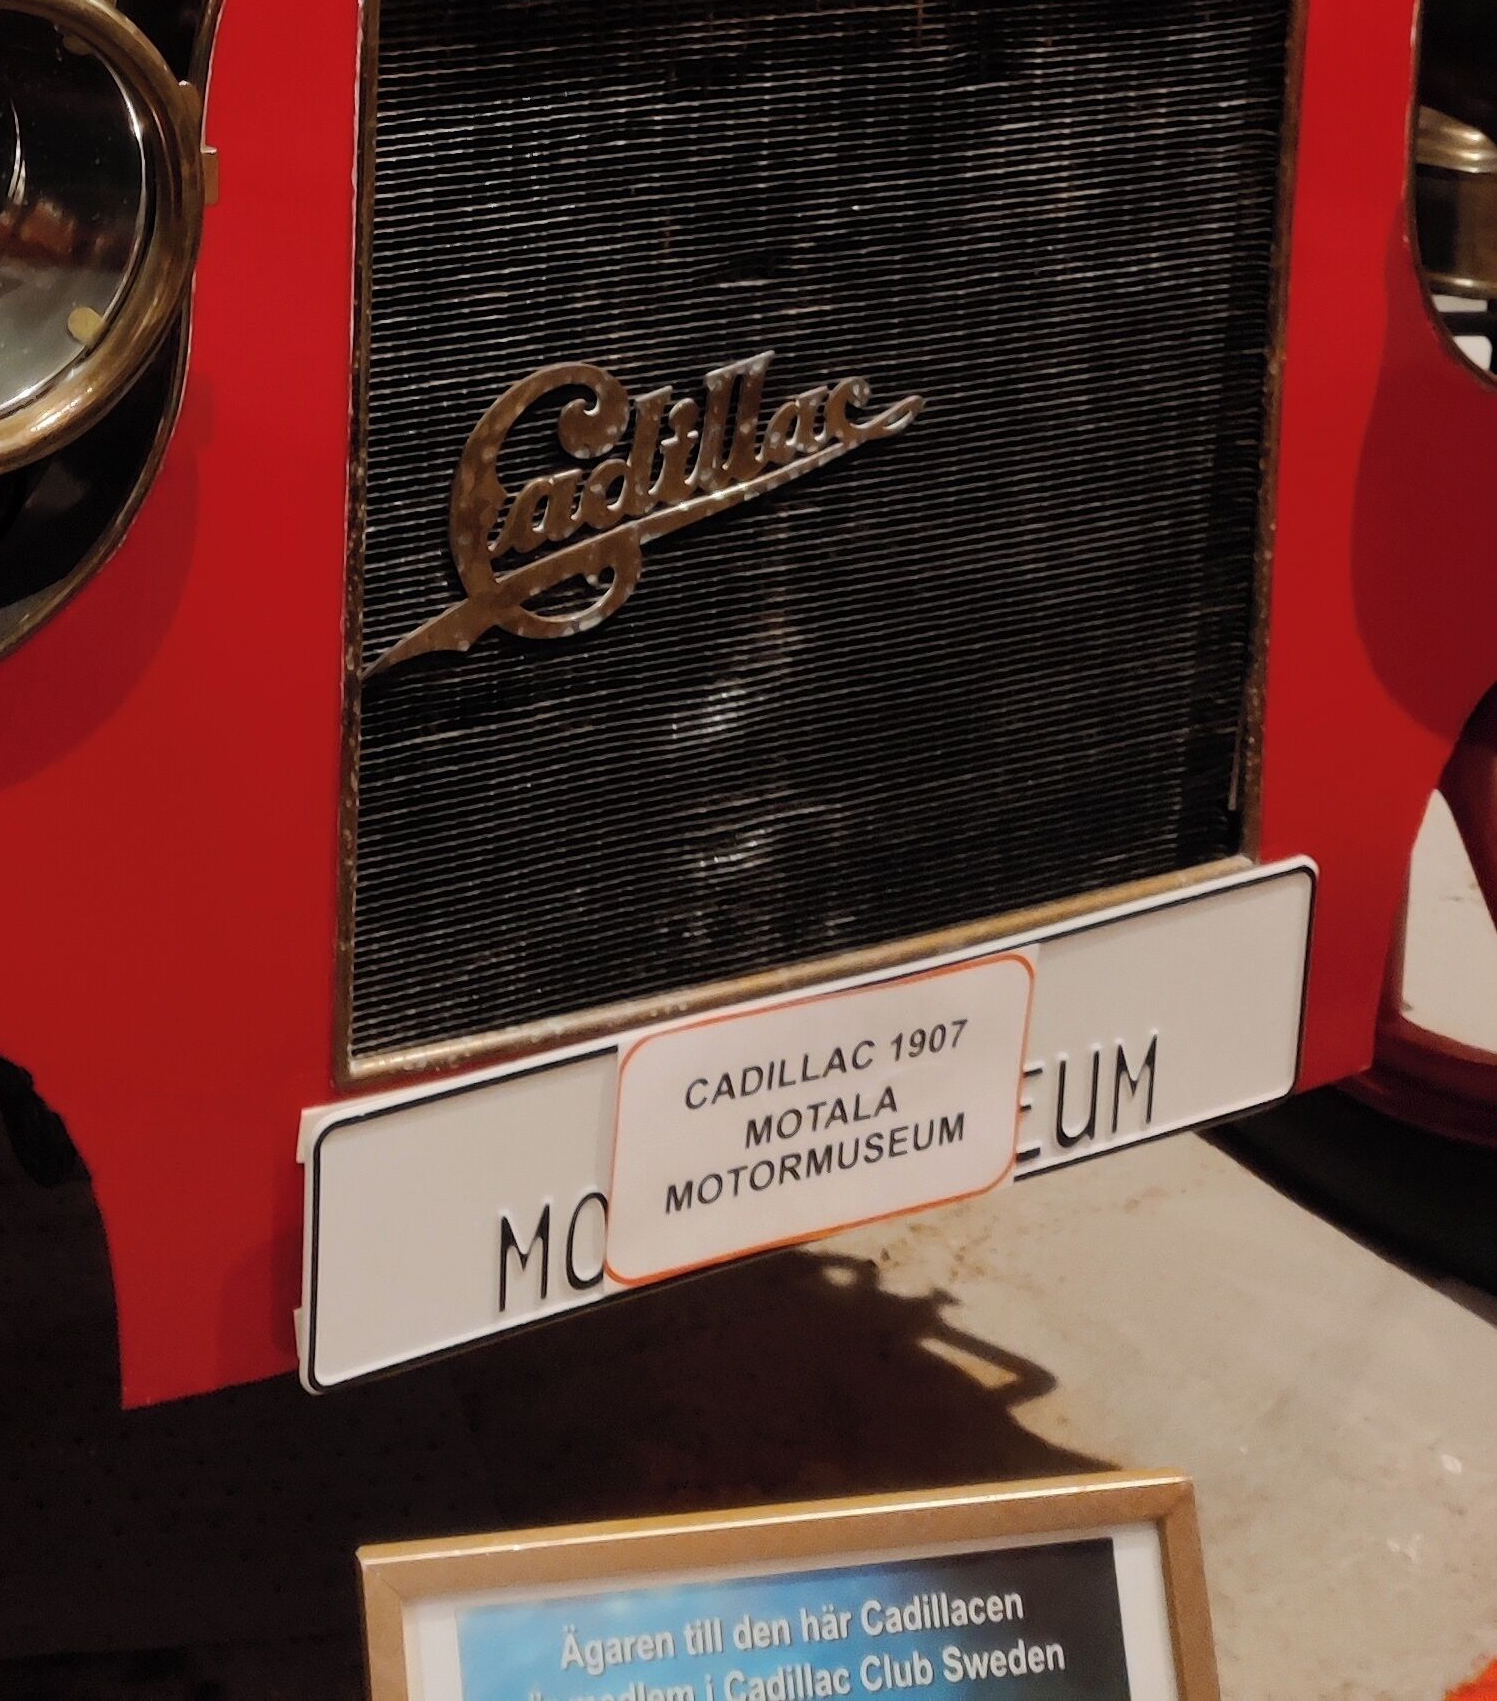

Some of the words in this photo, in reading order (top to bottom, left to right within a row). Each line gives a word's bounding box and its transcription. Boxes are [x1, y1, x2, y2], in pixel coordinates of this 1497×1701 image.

[447, 349, 925, 640] Cadillac
[684, 1039, 876, 1110] CADILLAC
[890, 1018, 968, 1062] 1907
[744, 1085, 898, 1149] MOTALA
[665, 1112, 965, 1214] MOTORMUSEUM
[560, 1623, 676, 1677] Ägaren
[683, 1616, 724, 1656] till
[733, 1611, 791, 1651] den
[800, 1603, 852, 1642] här
[860, 1592, 1024, 1637] Cadillacen
[724, 1661, 851, 1701] Cadillac
[860, 1650, 934, 1691] Club
[941, 1638, 1066, 1683] Sweden
